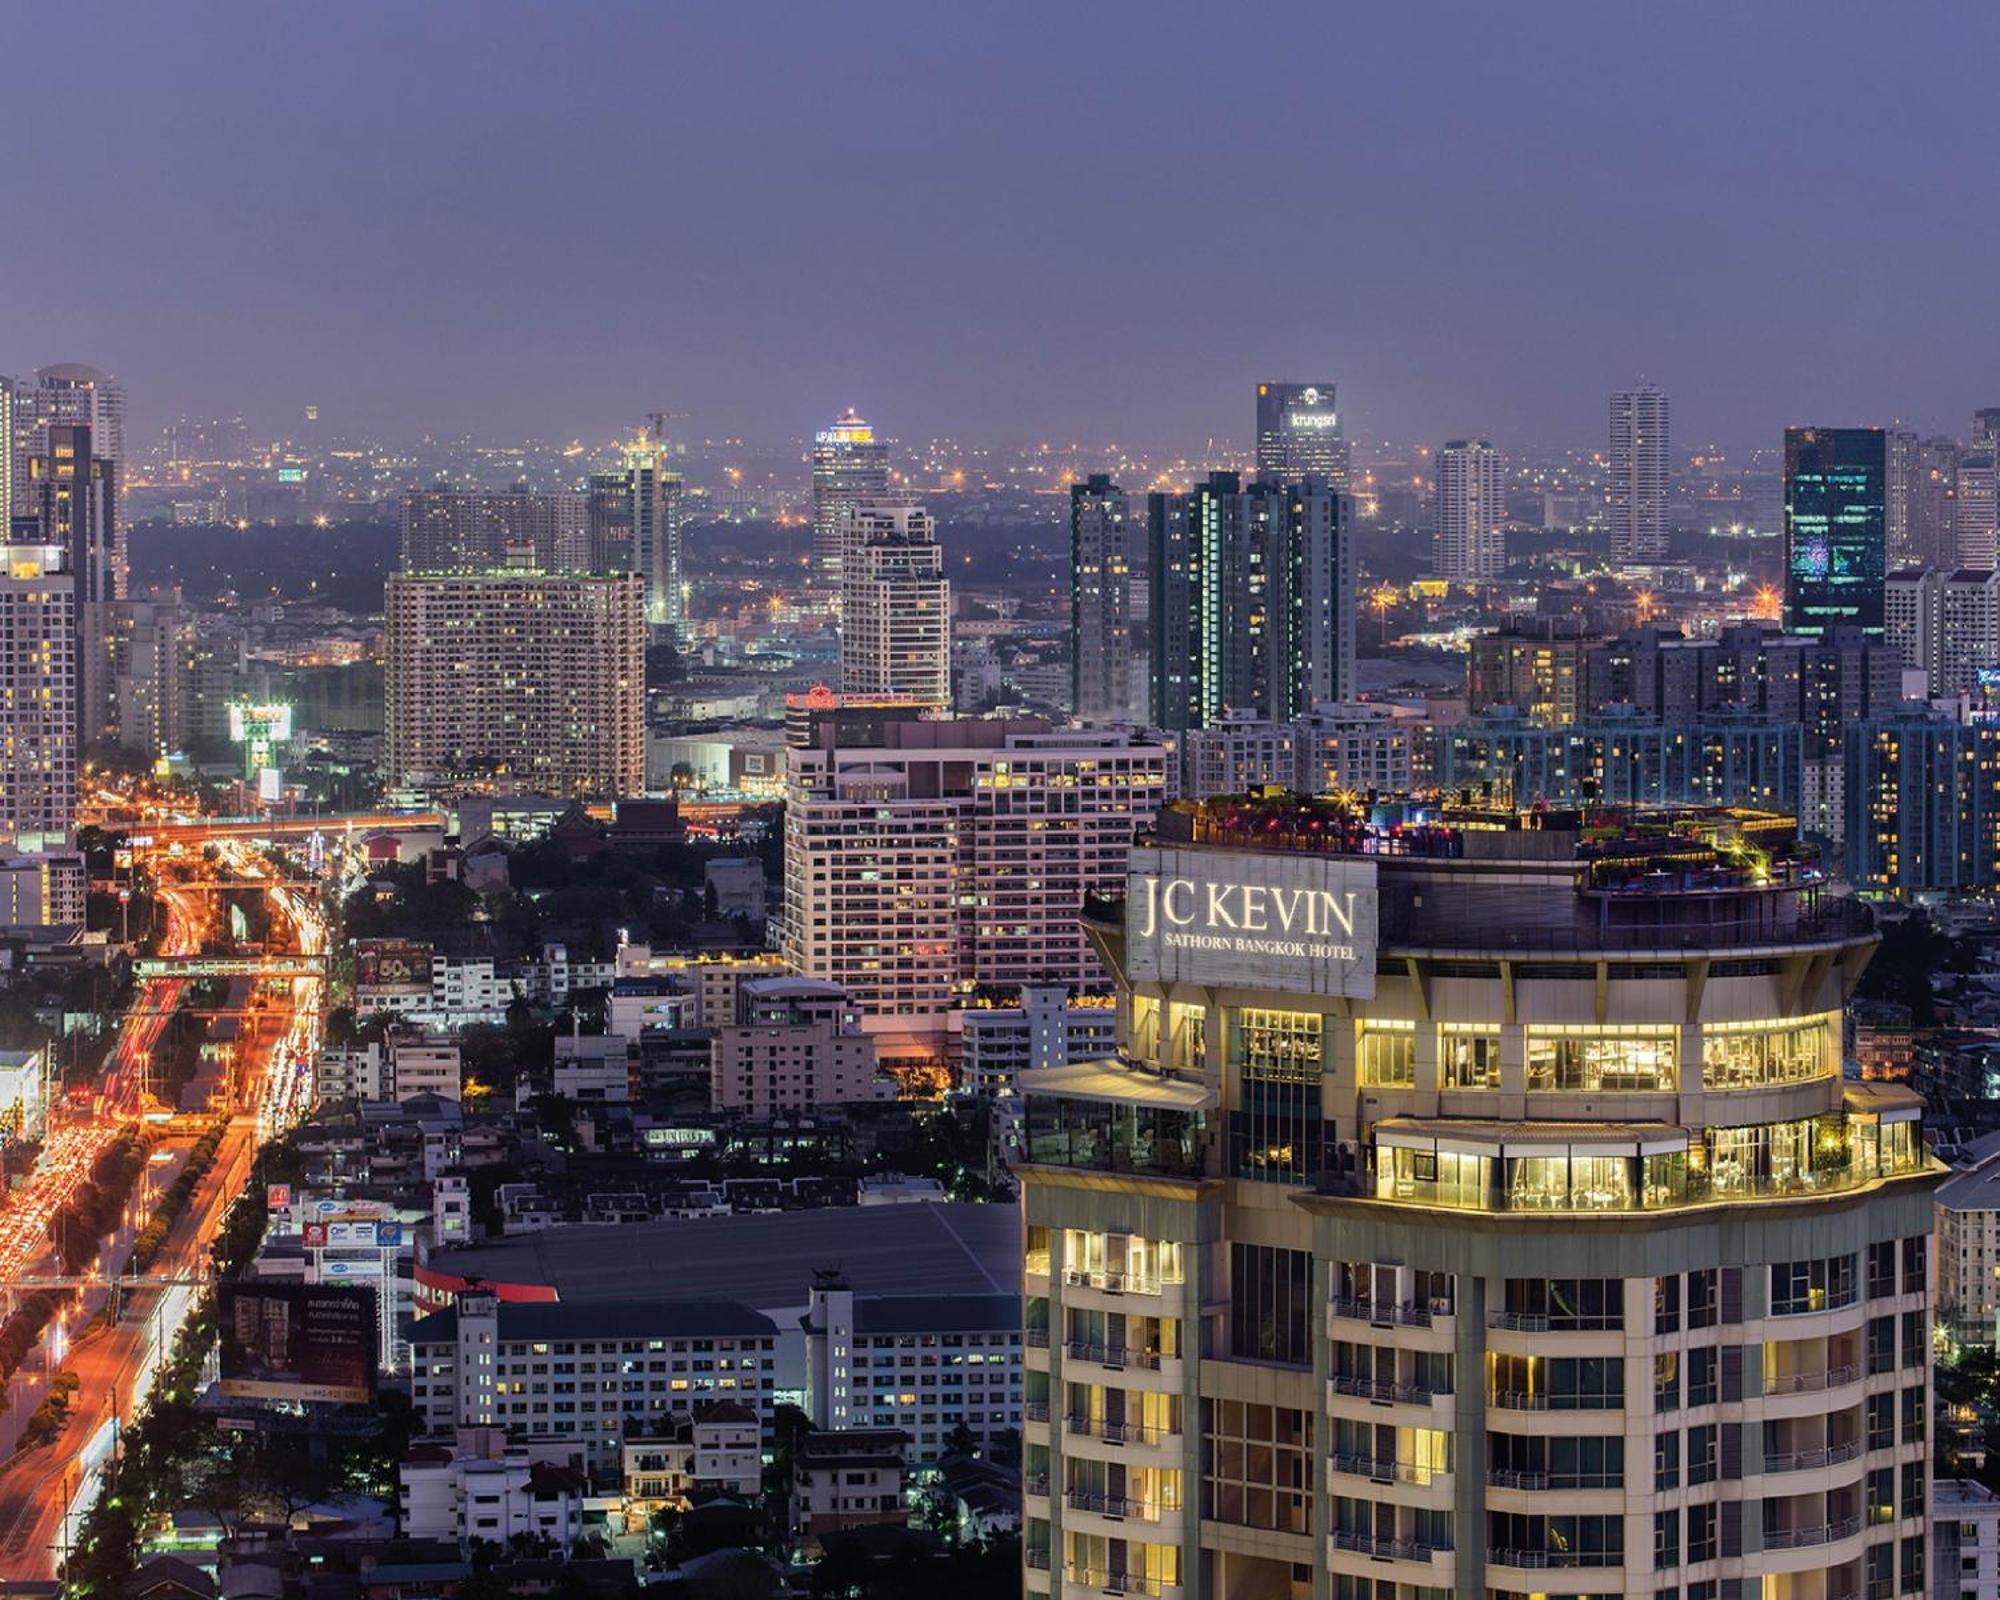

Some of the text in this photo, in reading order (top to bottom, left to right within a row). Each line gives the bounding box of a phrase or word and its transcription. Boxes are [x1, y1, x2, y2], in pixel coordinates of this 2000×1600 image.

[1292, 413, 1337, 429] krungsri
[1140, 879, 1357, 937] JC KEVIN
[1164, 933, 1356, 960] SATHORN BANGKOK HOTEL
